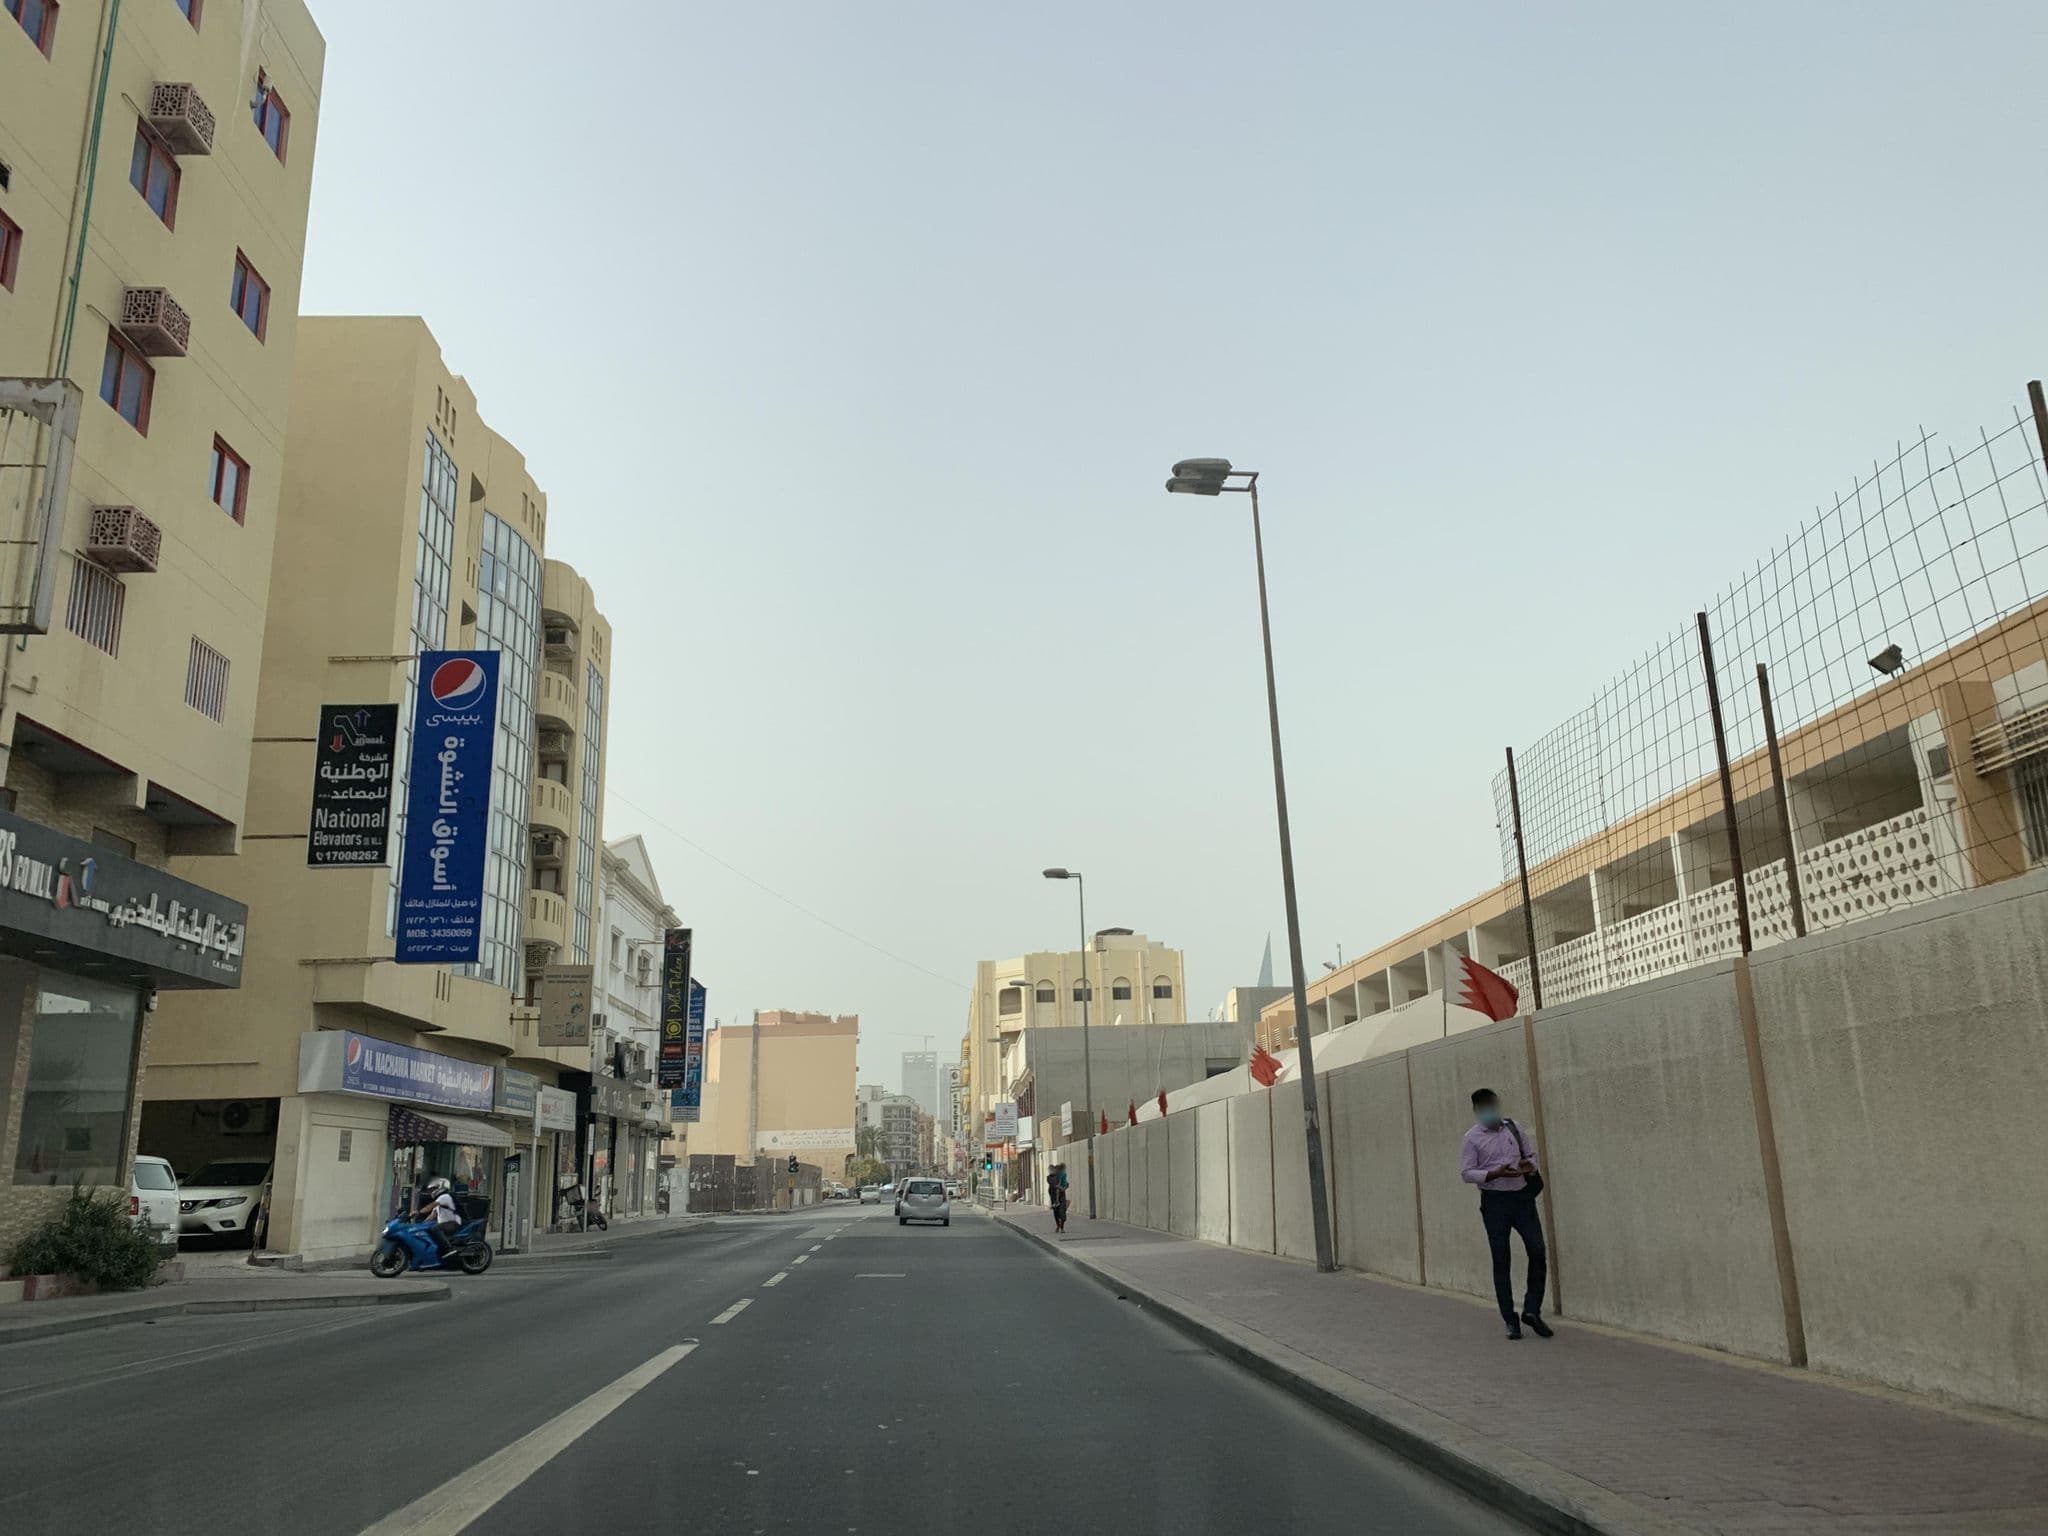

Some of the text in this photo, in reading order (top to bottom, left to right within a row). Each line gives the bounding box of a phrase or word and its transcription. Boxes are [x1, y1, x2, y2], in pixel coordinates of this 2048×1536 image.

[358, 752, 389, 763] الشركة
[320, 761, 389, 783] الوطنية
[437, 735, 465, 814] النشوة
[331, 786, 388, 799] للمصاعد
[314, 807, 386, 829] National
[312, 830, 363, 846] Elevators
[363, 1049, 373, 1072] AL
[410, 1059, 436, 1084] MARKET
